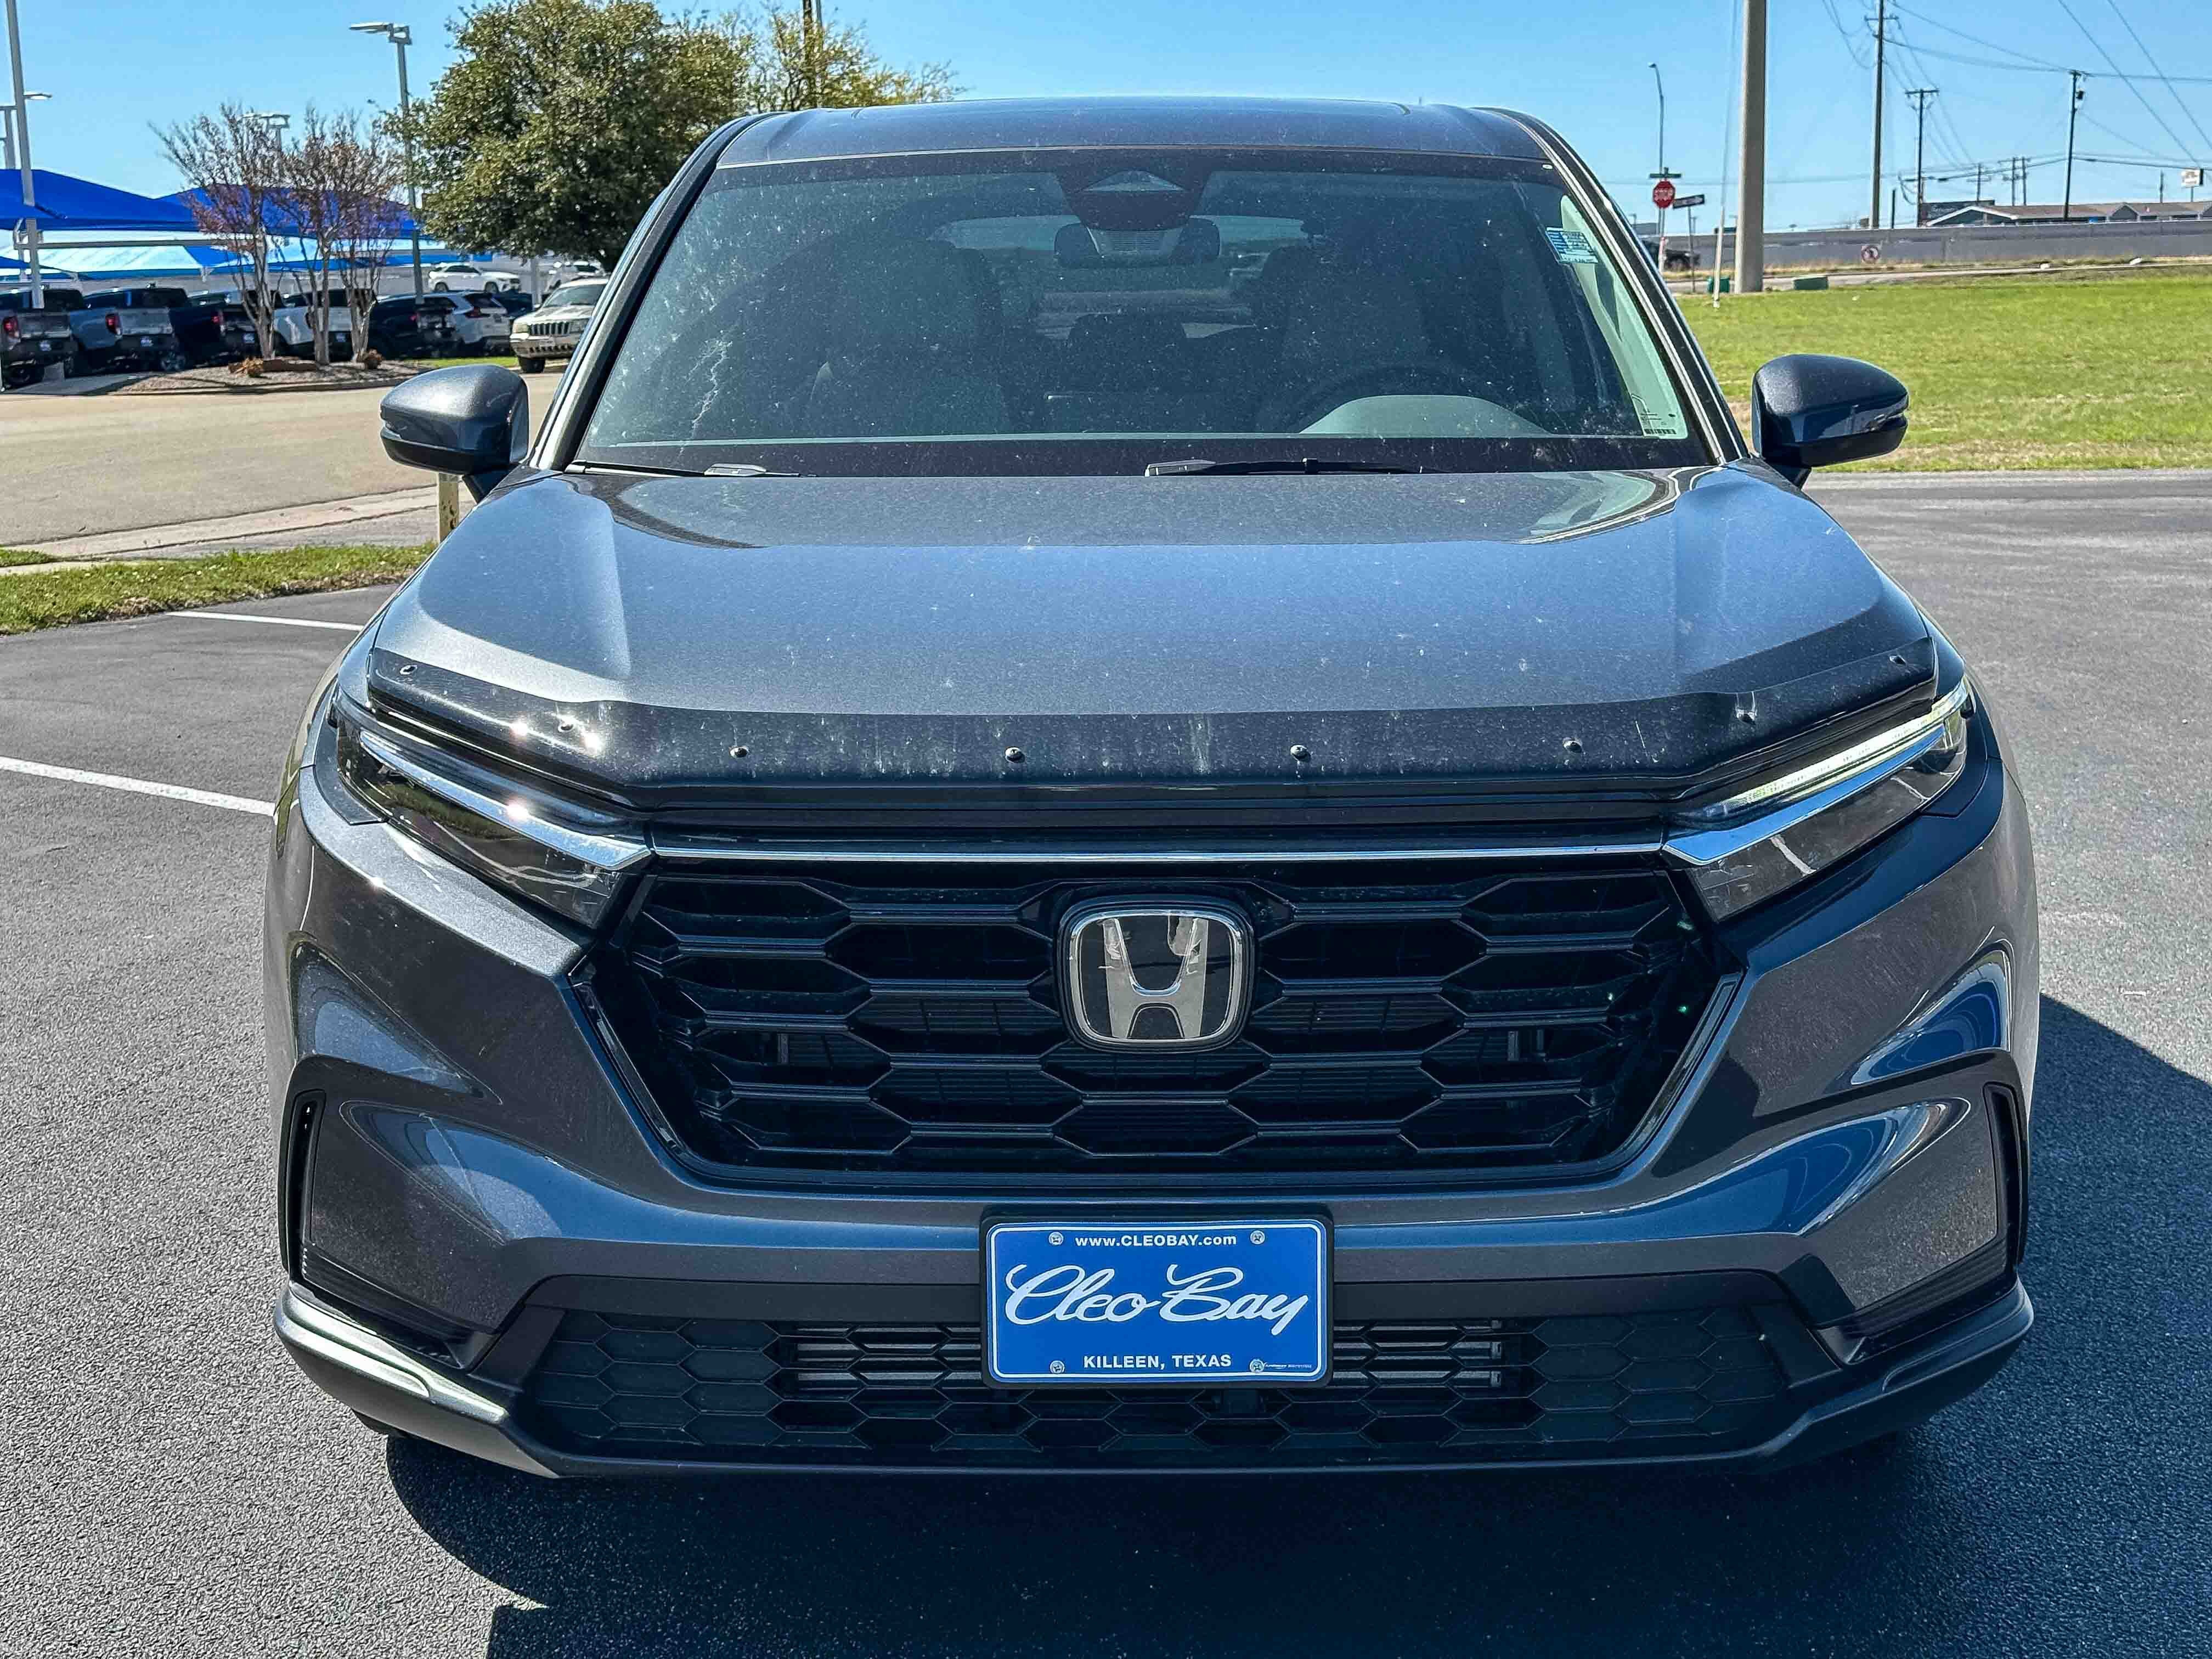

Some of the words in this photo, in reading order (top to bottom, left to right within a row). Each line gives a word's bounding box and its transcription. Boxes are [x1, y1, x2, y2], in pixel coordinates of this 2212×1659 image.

[1075, 1234, 1237, 1246] www.CLEOBAY.com
[1005, 1264, 1159, 1325] Cleo
[1159, 1264, 1308, 1335] Bay
[1084, 1356, 1165, 1370] KILLEEN,
[1171, 1354, 1231, 1367] TEXAS
